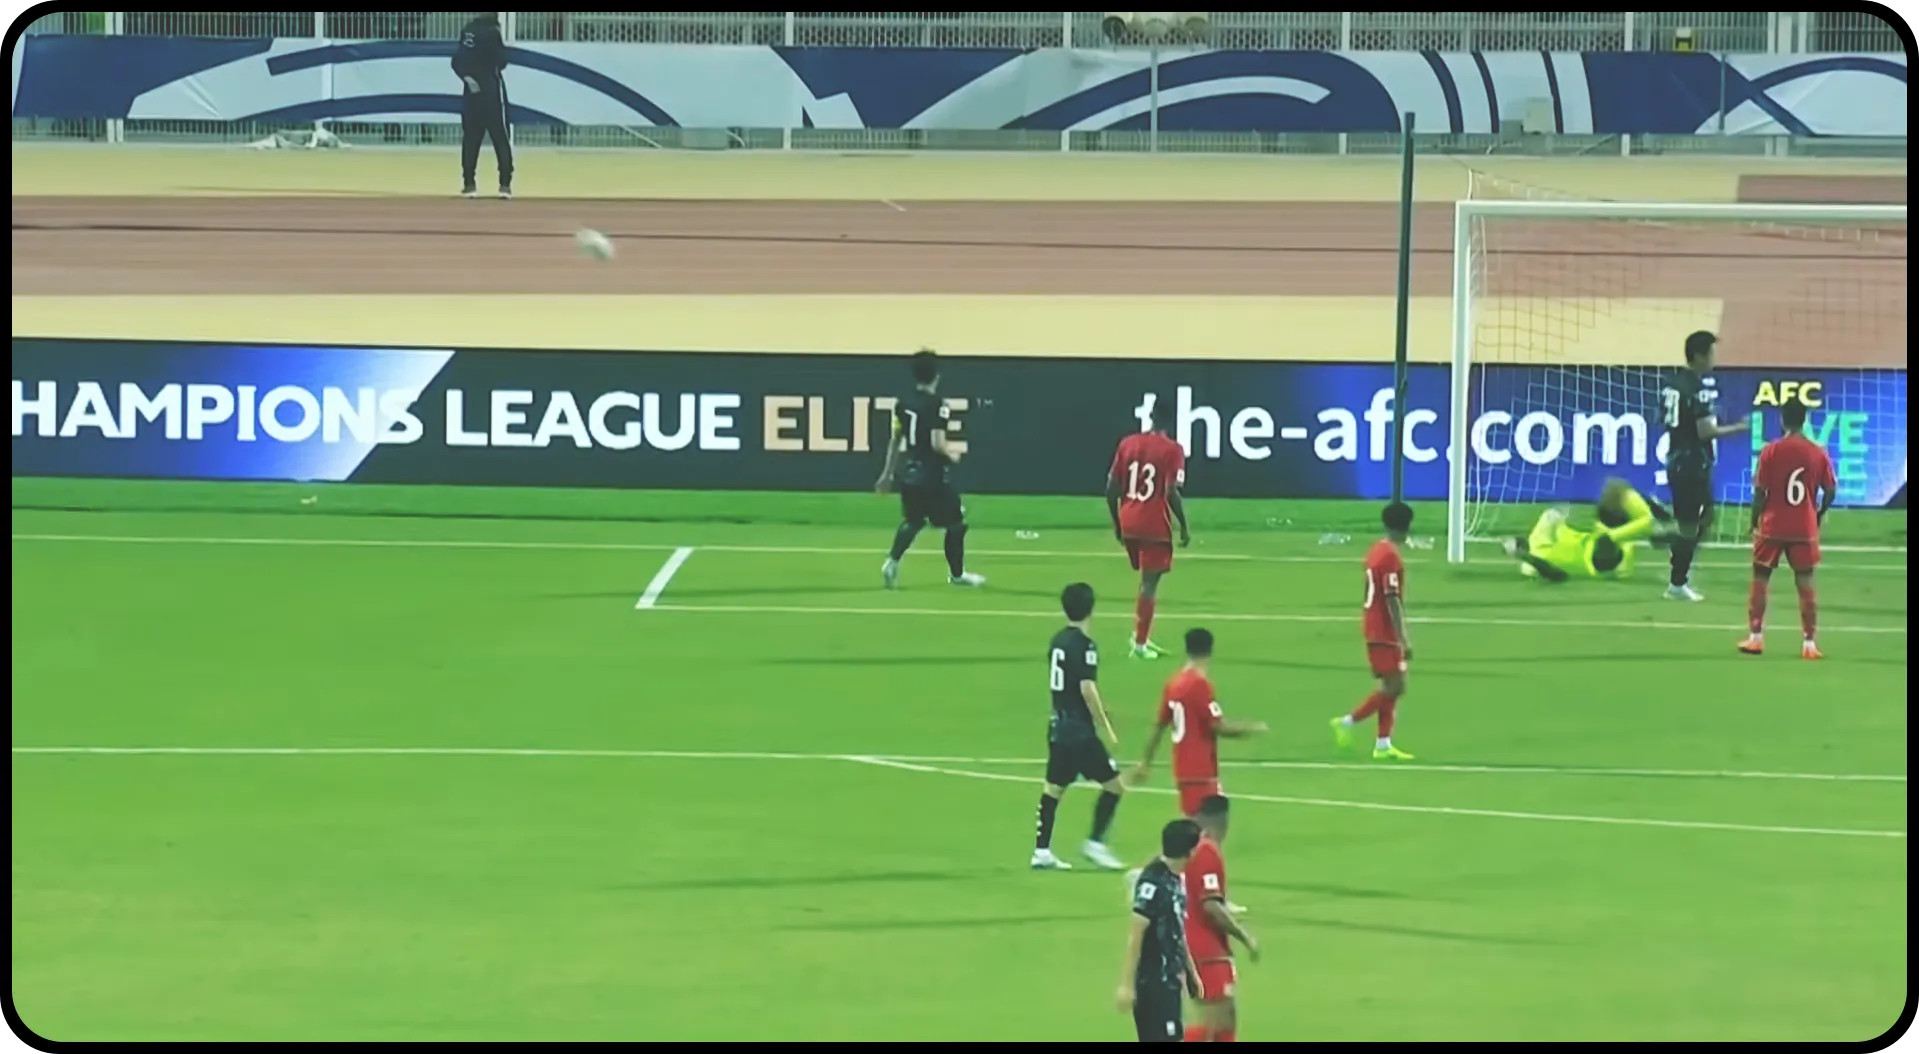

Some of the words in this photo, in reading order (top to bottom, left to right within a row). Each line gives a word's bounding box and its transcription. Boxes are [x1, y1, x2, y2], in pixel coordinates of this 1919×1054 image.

[1753, 380, 1823, 408] AFC
[12, 380, 423, 445] HAMPIONS
[446, 389, 741, 451] LEAGUE
[1751, 410, 1869, 453] LVE
[1126, 460, 1156, 502] 13
[1786, 467, 1805, 506] 6
[1050, 648, 1065, 691] 6
